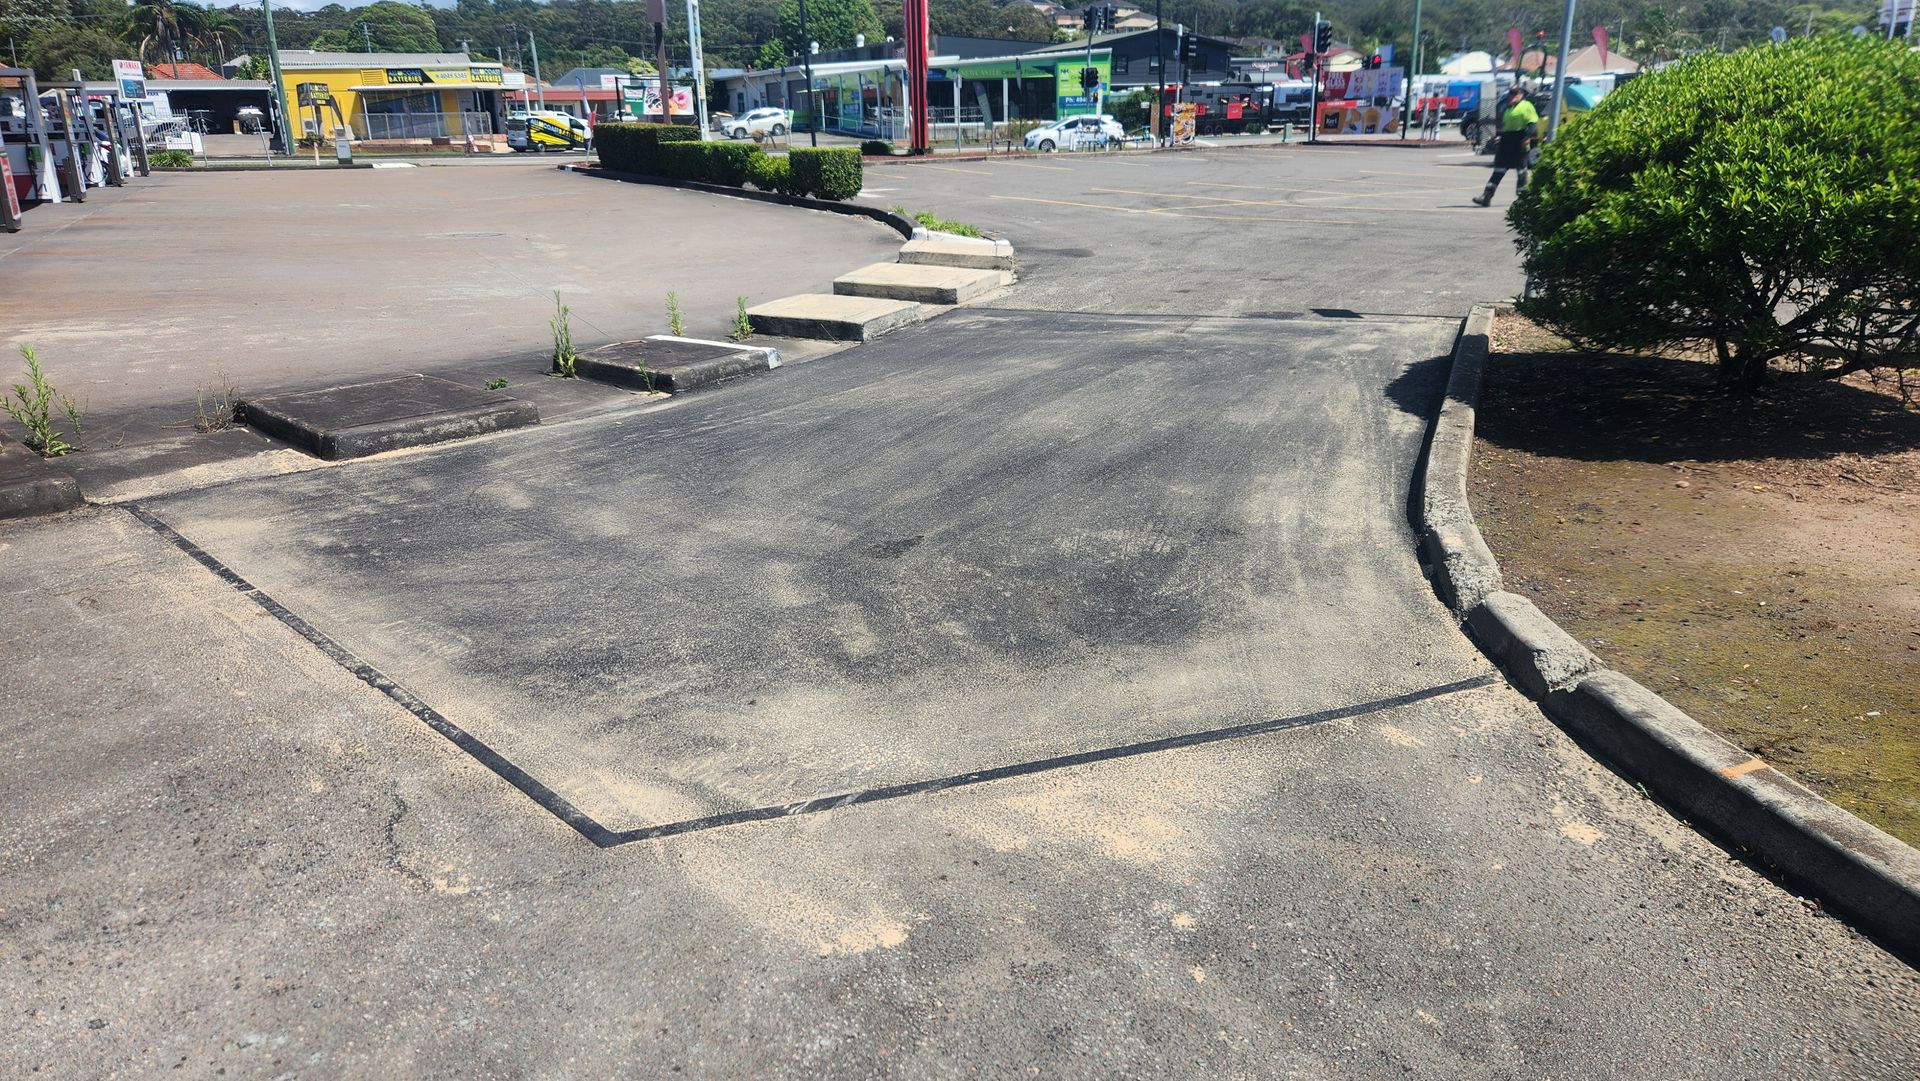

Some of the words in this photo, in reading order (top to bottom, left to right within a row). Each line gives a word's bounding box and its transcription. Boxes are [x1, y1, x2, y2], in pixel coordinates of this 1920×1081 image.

[1328, 72, 1344, 80] FREE
[1325, 79, 1345, 89] GLASS
[543, 123, 558, 133] COAST
